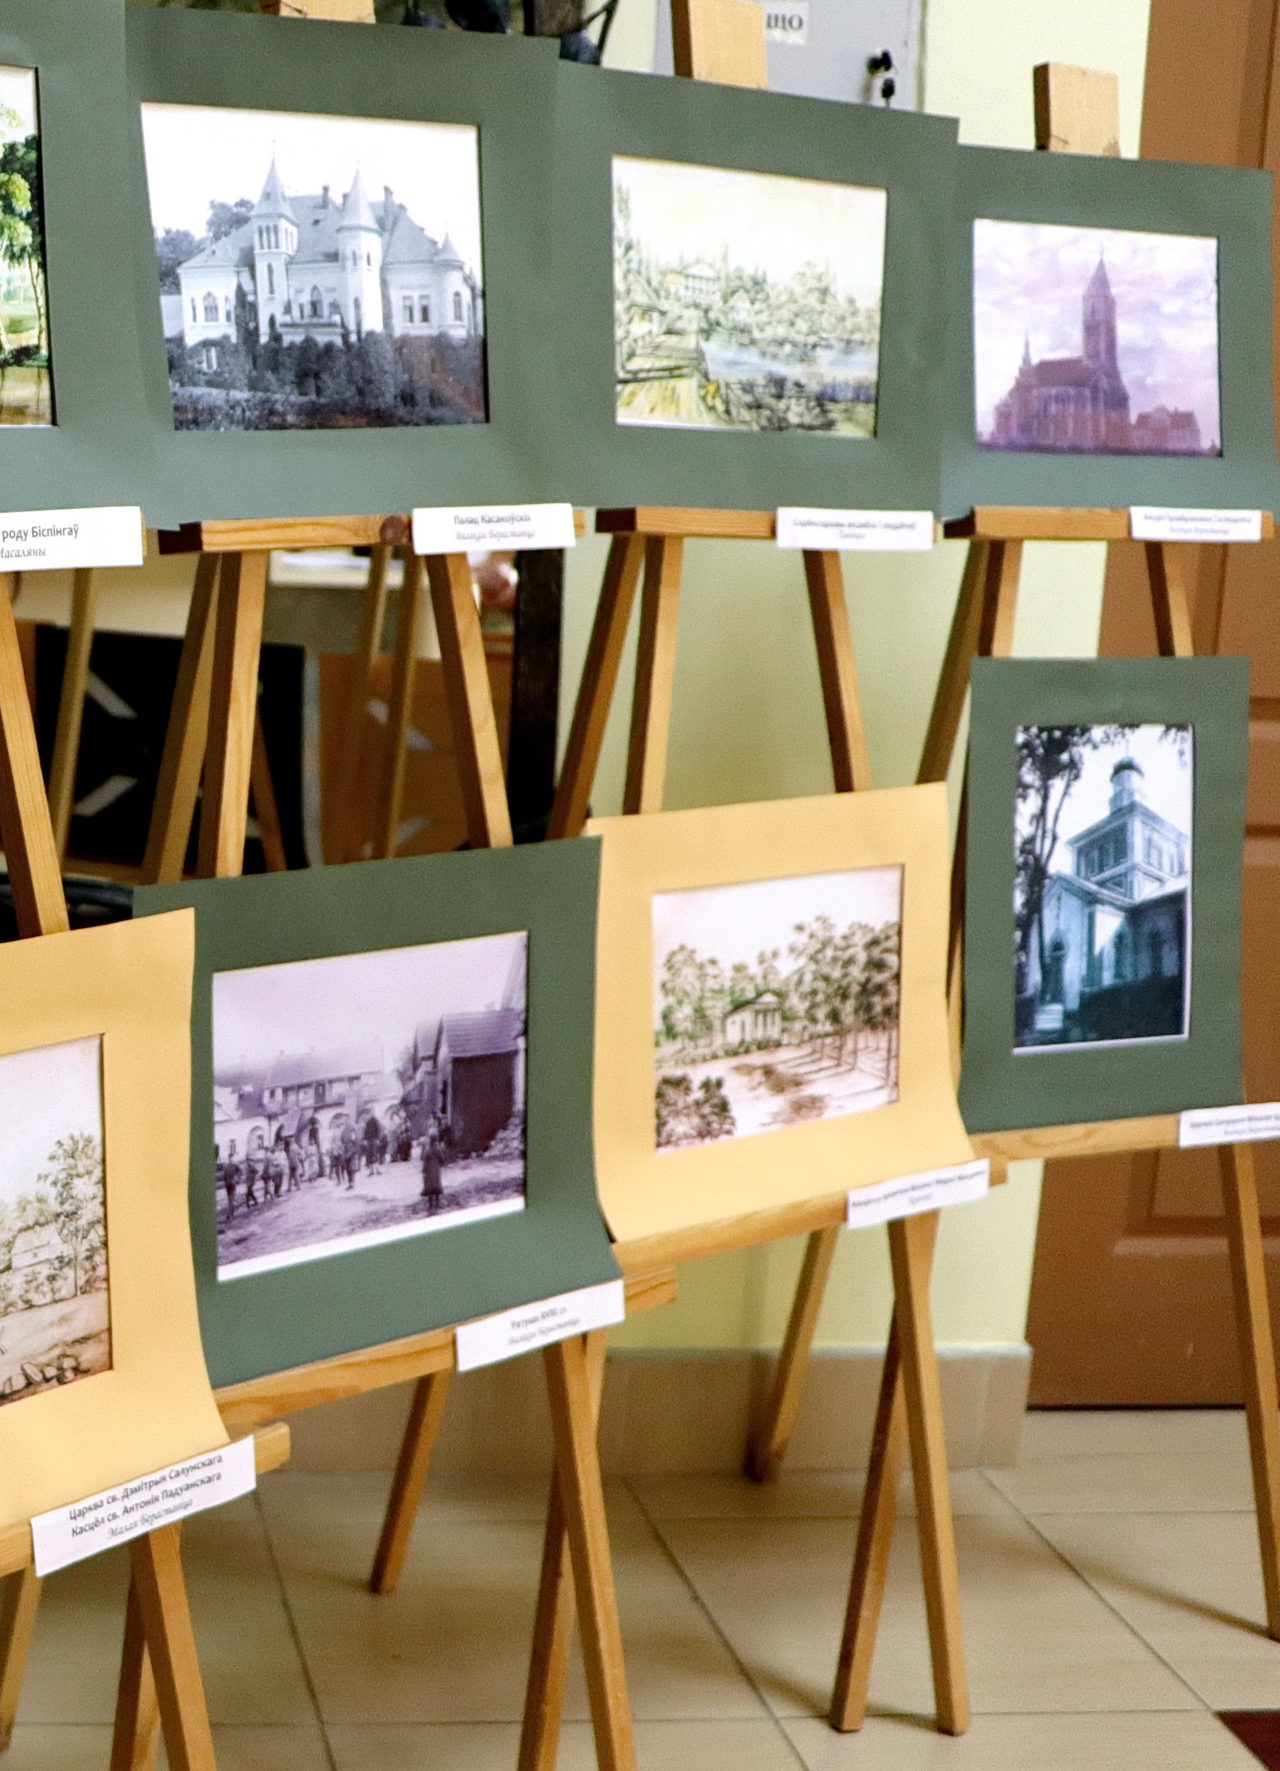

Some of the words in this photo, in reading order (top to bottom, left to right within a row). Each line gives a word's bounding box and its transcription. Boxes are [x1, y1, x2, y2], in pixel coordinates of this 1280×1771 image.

[2, 530, 29, 542] роду
[31, 524, 79, 539] Біспінгаў
[69, 1499, 104, 1521] Царква
[106, 1493, 120, 1505] св.
[168, 1453, 223, 1481] Салунскага
[71, 1516, 105, 1537] Касцёл
[107, 1511, 121, 1523] св.
[122, 1495, 160, 1515] Антонія
[161, 1471, 222, 1499] Падуанскага
